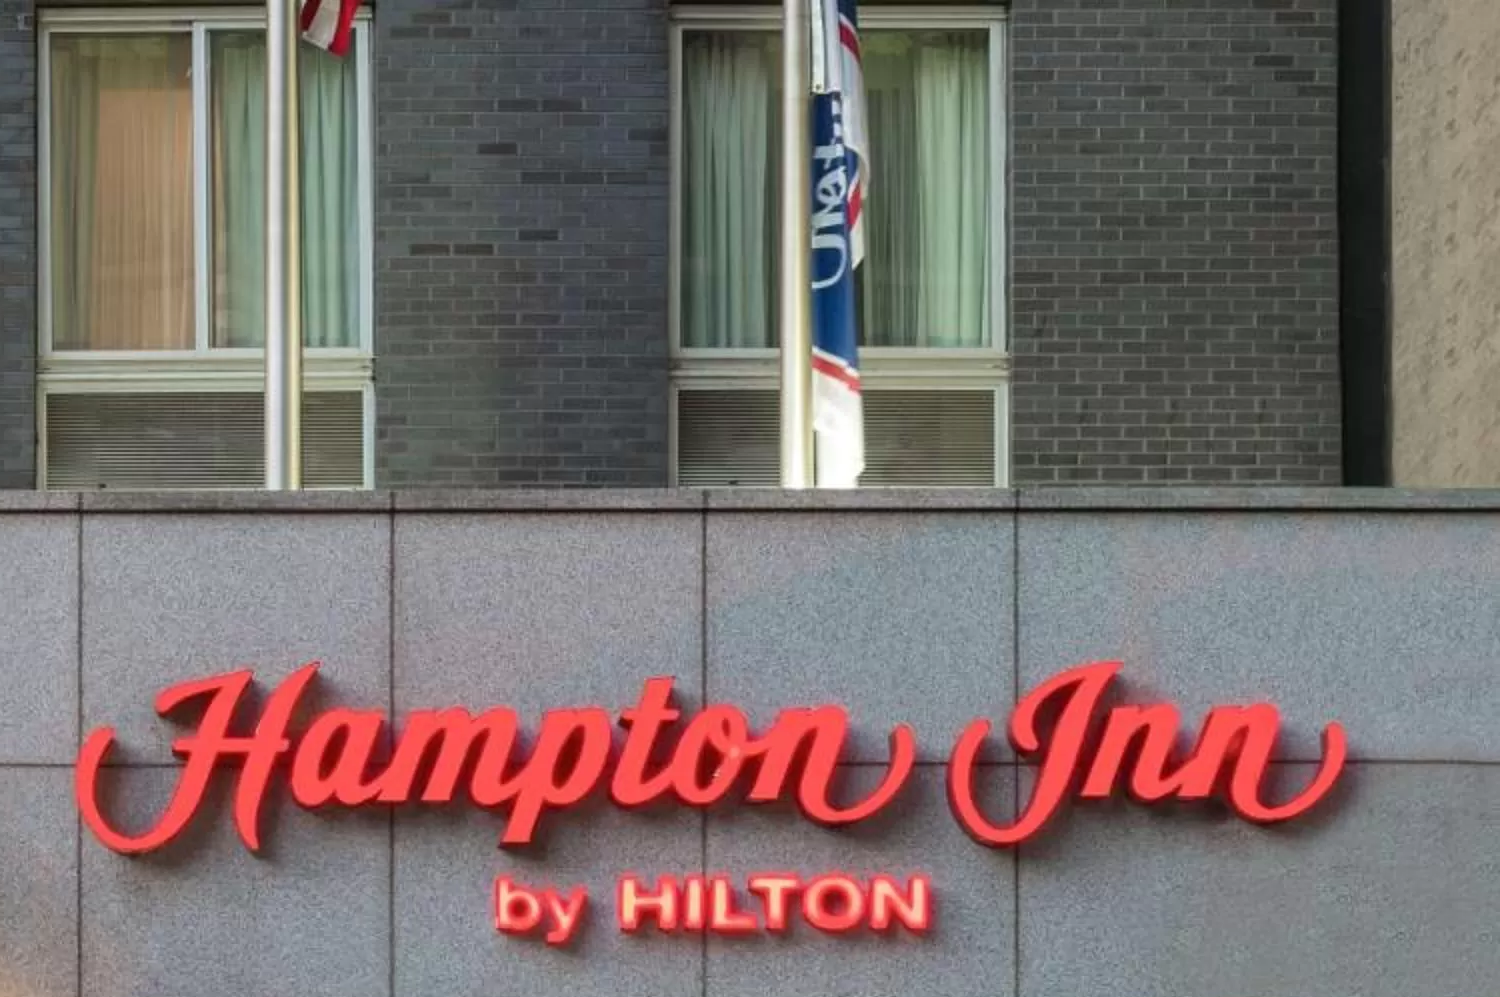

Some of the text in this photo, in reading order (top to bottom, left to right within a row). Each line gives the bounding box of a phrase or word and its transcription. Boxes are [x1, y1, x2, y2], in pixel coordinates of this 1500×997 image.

[75, 661, 1348, 855] Hampton Inn
[494, 873, 933, 944] by HILTON
